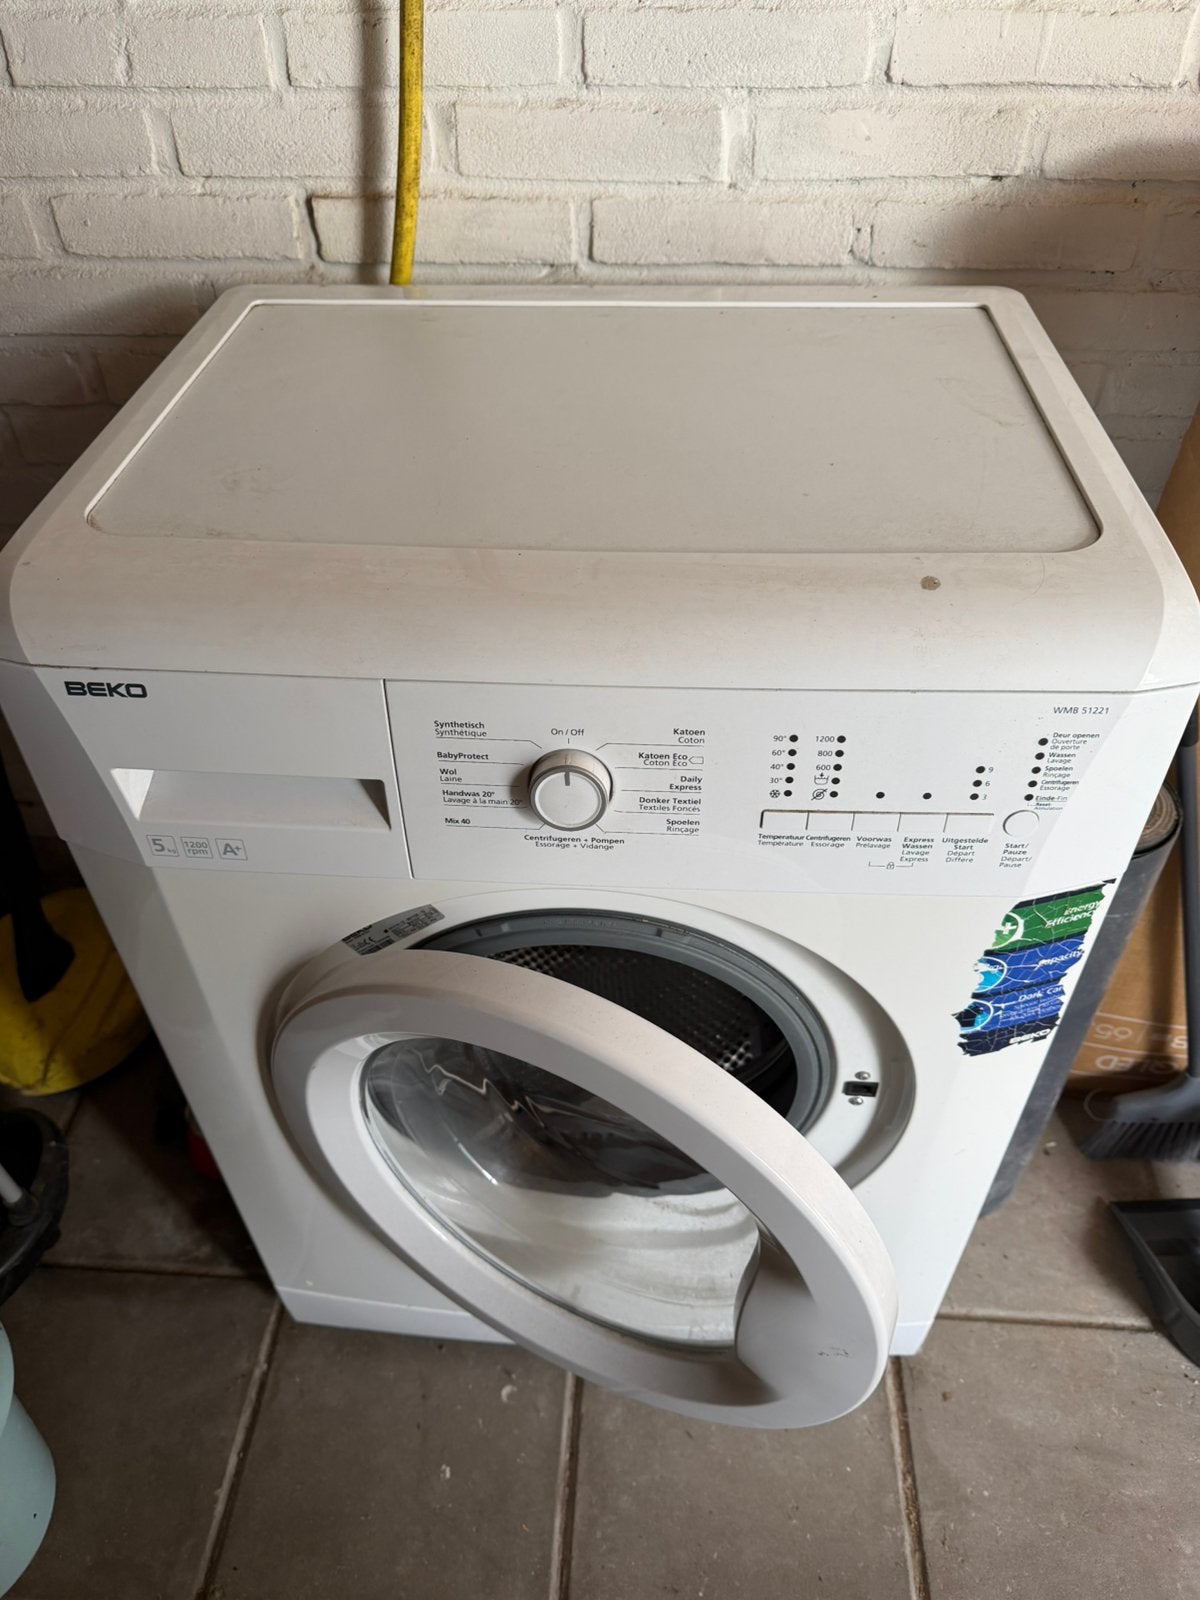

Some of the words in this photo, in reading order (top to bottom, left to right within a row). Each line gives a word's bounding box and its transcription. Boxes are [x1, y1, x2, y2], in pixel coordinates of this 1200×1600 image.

[64, 681, 147, 698] BEKO
[435, 720, 484, 729] Synthetisch
[435, 729, 487, 737] Synthétique
[551, 728, 563, 736] On
[570, 728, 584, 736] Off
[673, 728, 705, 736] Katoen
[437, 752, 488, 761] BabyProtect
[638, 752, 670, 760] Katoen
[440, 775, 462, 783] Laine
[680, 776, 702, 785] Daily
[669, 783, 702, 792] Express
[442, 789, 480, 797] Handwas
[443, 797, 469, 805] Lavage
[672, 797, 701, 805] Textiel
[672, 804, 700, 812] Foncés
[666, 818, 700, 827] Spoelen
[666, 826, 699, 834] Rinçage
[524, 834, 581, 844] Centrifugeren
[591, 837, 625, 846] Pompen
[152, 839, 165, 852] 5
[223, 843, 242, 856] A+
[535, 841, 570, 850] Essorage
